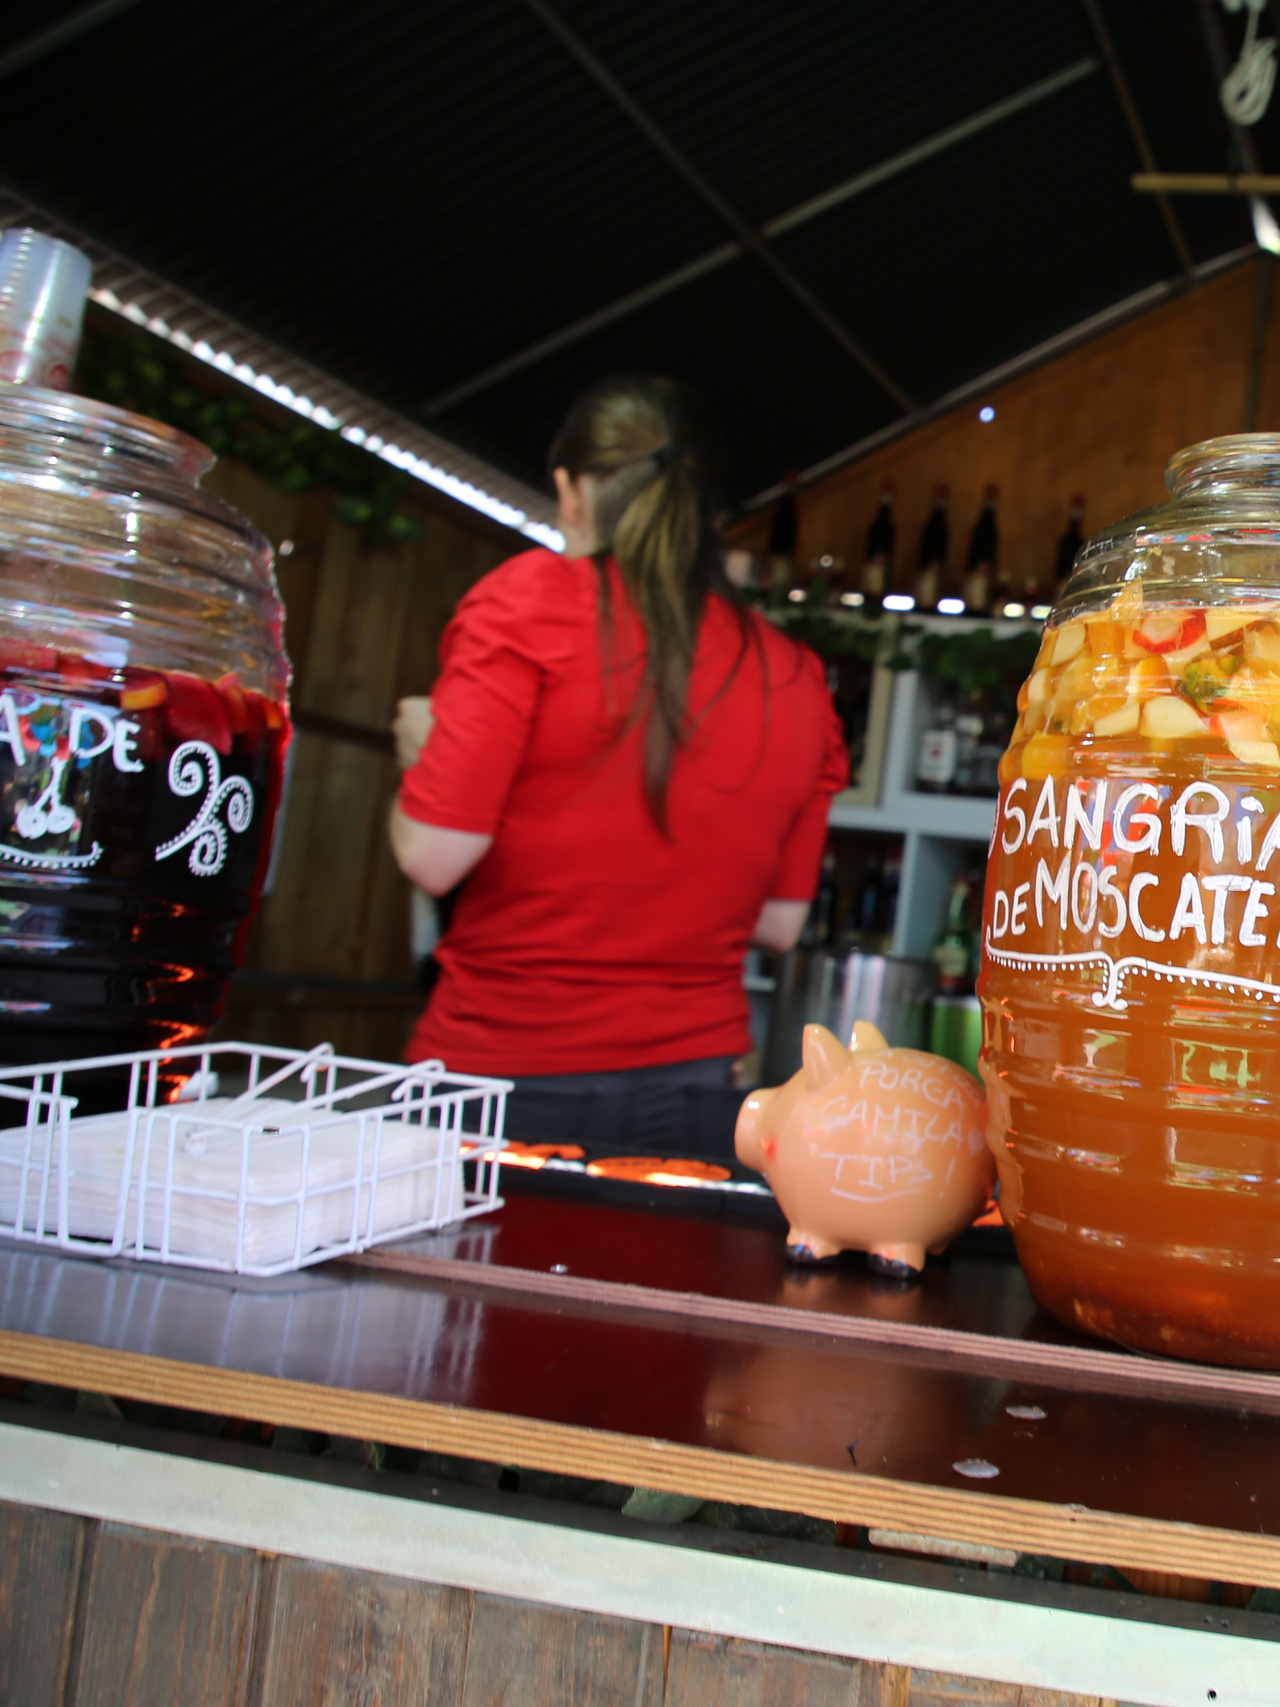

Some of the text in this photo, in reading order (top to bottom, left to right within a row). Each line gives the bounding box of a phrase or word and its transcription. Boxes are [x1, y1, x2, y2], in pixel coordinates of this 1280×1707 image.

[67, 706, 145, 773] DE
[993, 881, 1031, 939] DE
[820, 1095, 964, 1150] CAMILA
